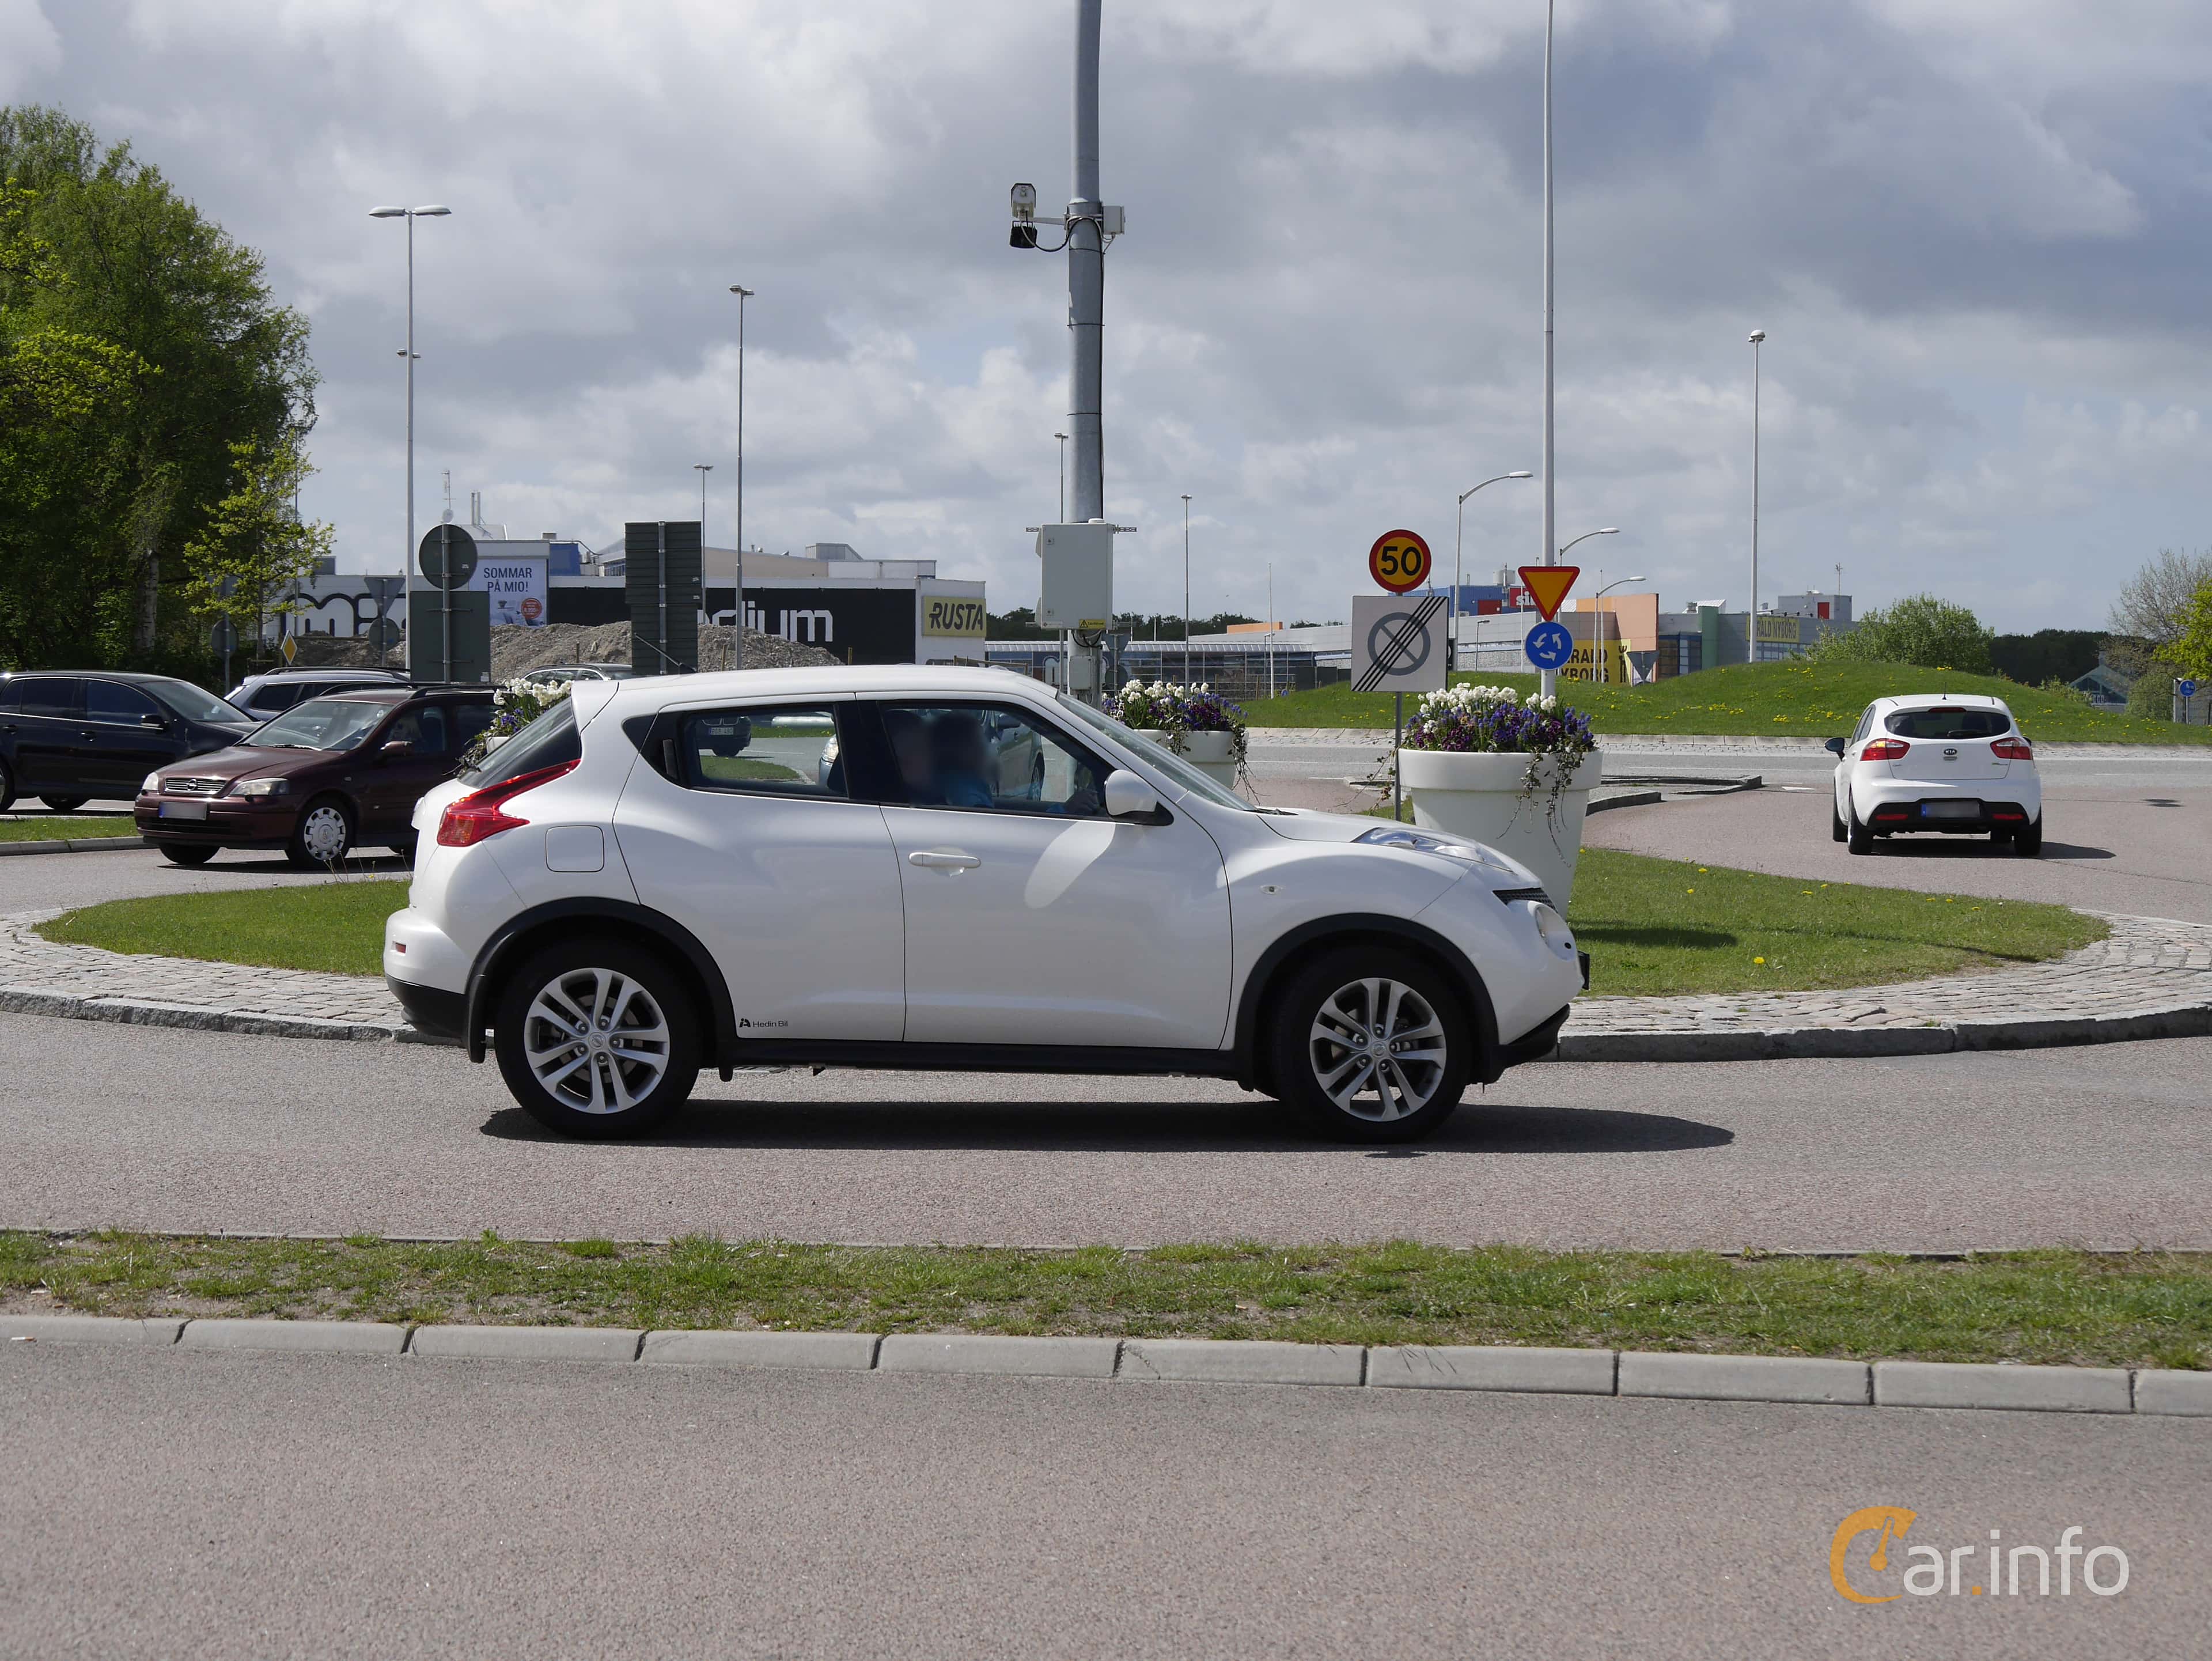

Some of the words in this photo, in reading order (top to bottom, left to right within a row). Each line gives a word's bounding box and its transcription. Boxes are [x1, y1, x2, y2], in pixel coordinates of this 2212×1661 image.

[1381, 546, 1421, 576] 50
[484, 567, 532, 578] SOMMAR
[488, 579, 501, 592] PÅ
[504, 581, 529, 592] MIO!
[1516, 591, 1536, 606] si
[697, 600, 833, 642] dium
[929, 602, 983, 631] RUSTA
[1567, 649, 1608, 664] RALD
